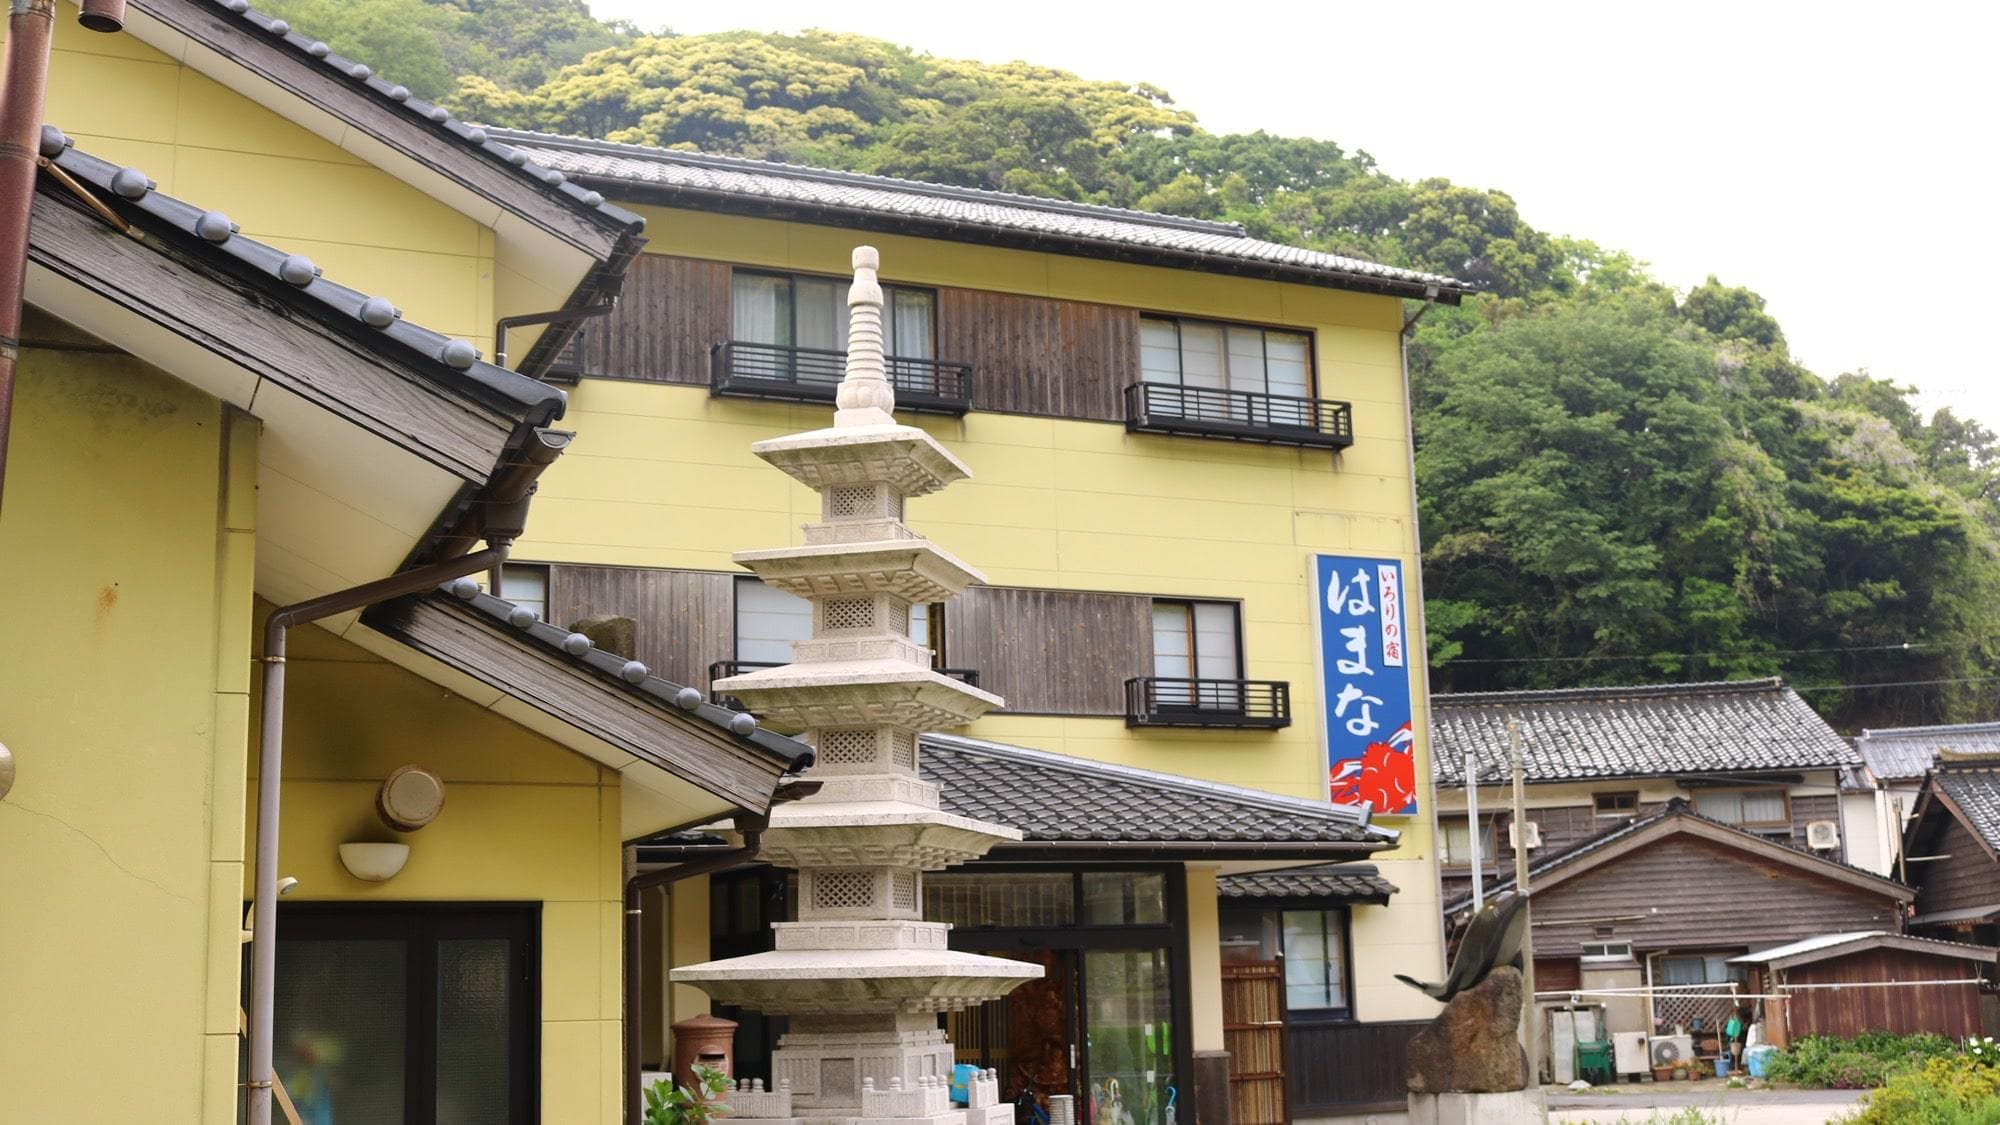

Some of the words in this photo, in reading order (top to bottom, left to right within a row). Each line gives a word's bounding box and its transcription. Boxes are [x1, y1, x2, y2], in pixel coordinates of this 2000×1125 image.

[1327, 567, 1383, 736] はまな
[1381, 571, 1399, 659] いろりの宿
